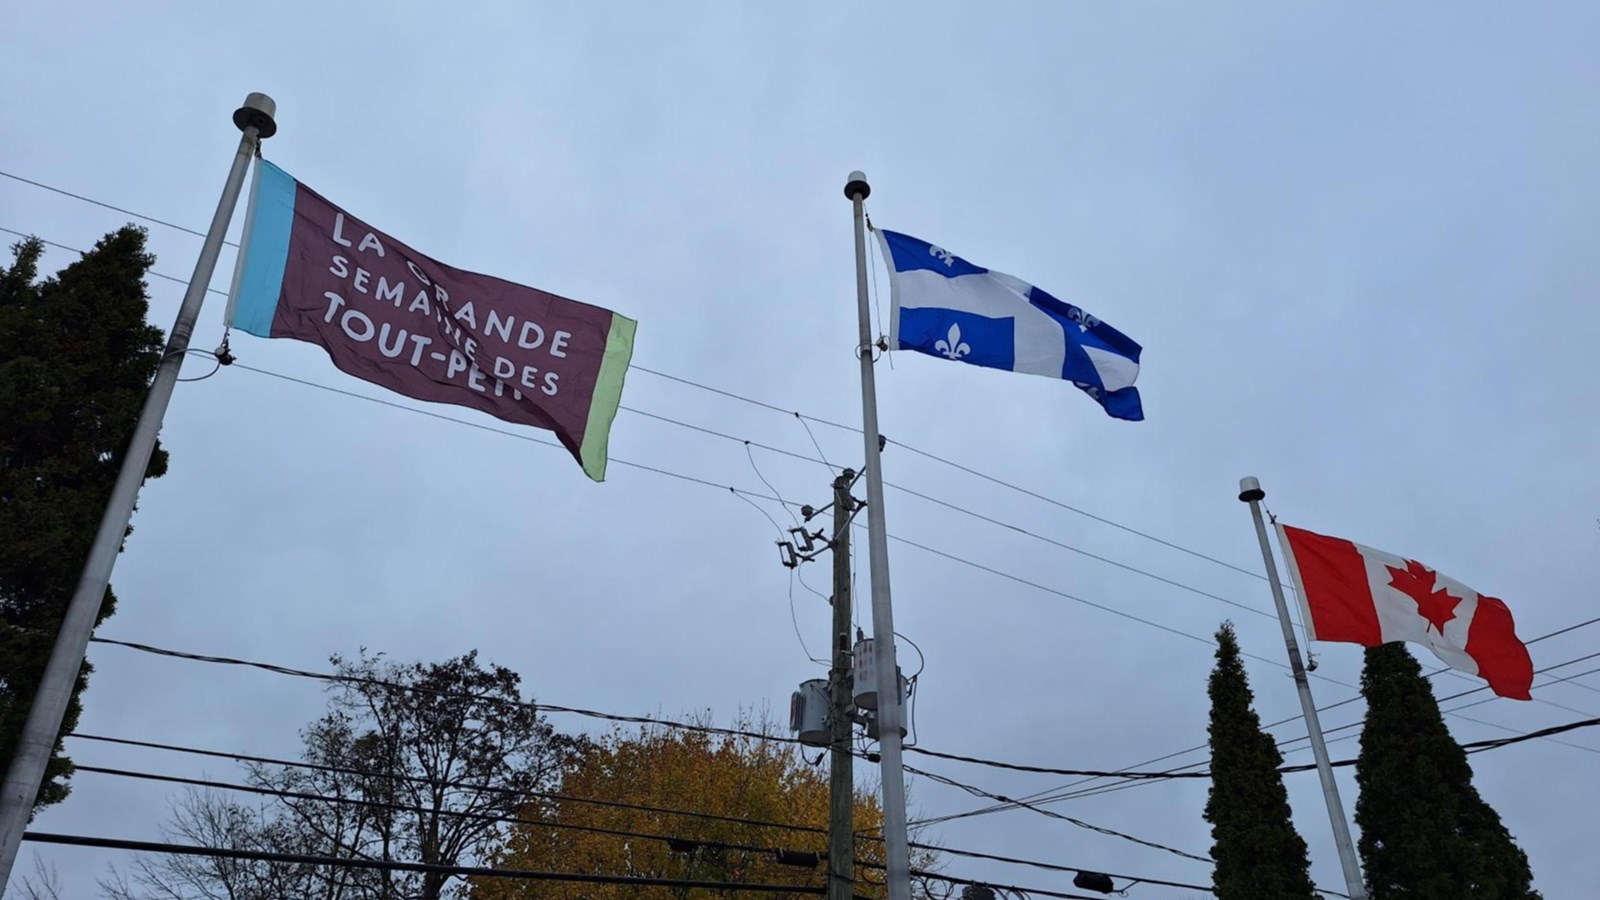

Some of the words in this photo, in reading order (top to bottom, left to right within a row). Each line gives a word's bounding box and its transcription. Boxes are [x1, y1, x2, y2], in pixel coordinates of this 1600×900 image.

[332, 212, 385, 257] LA
[406, 260, 572, 358] GRANDE
[493, 356, 560, 396] DES
